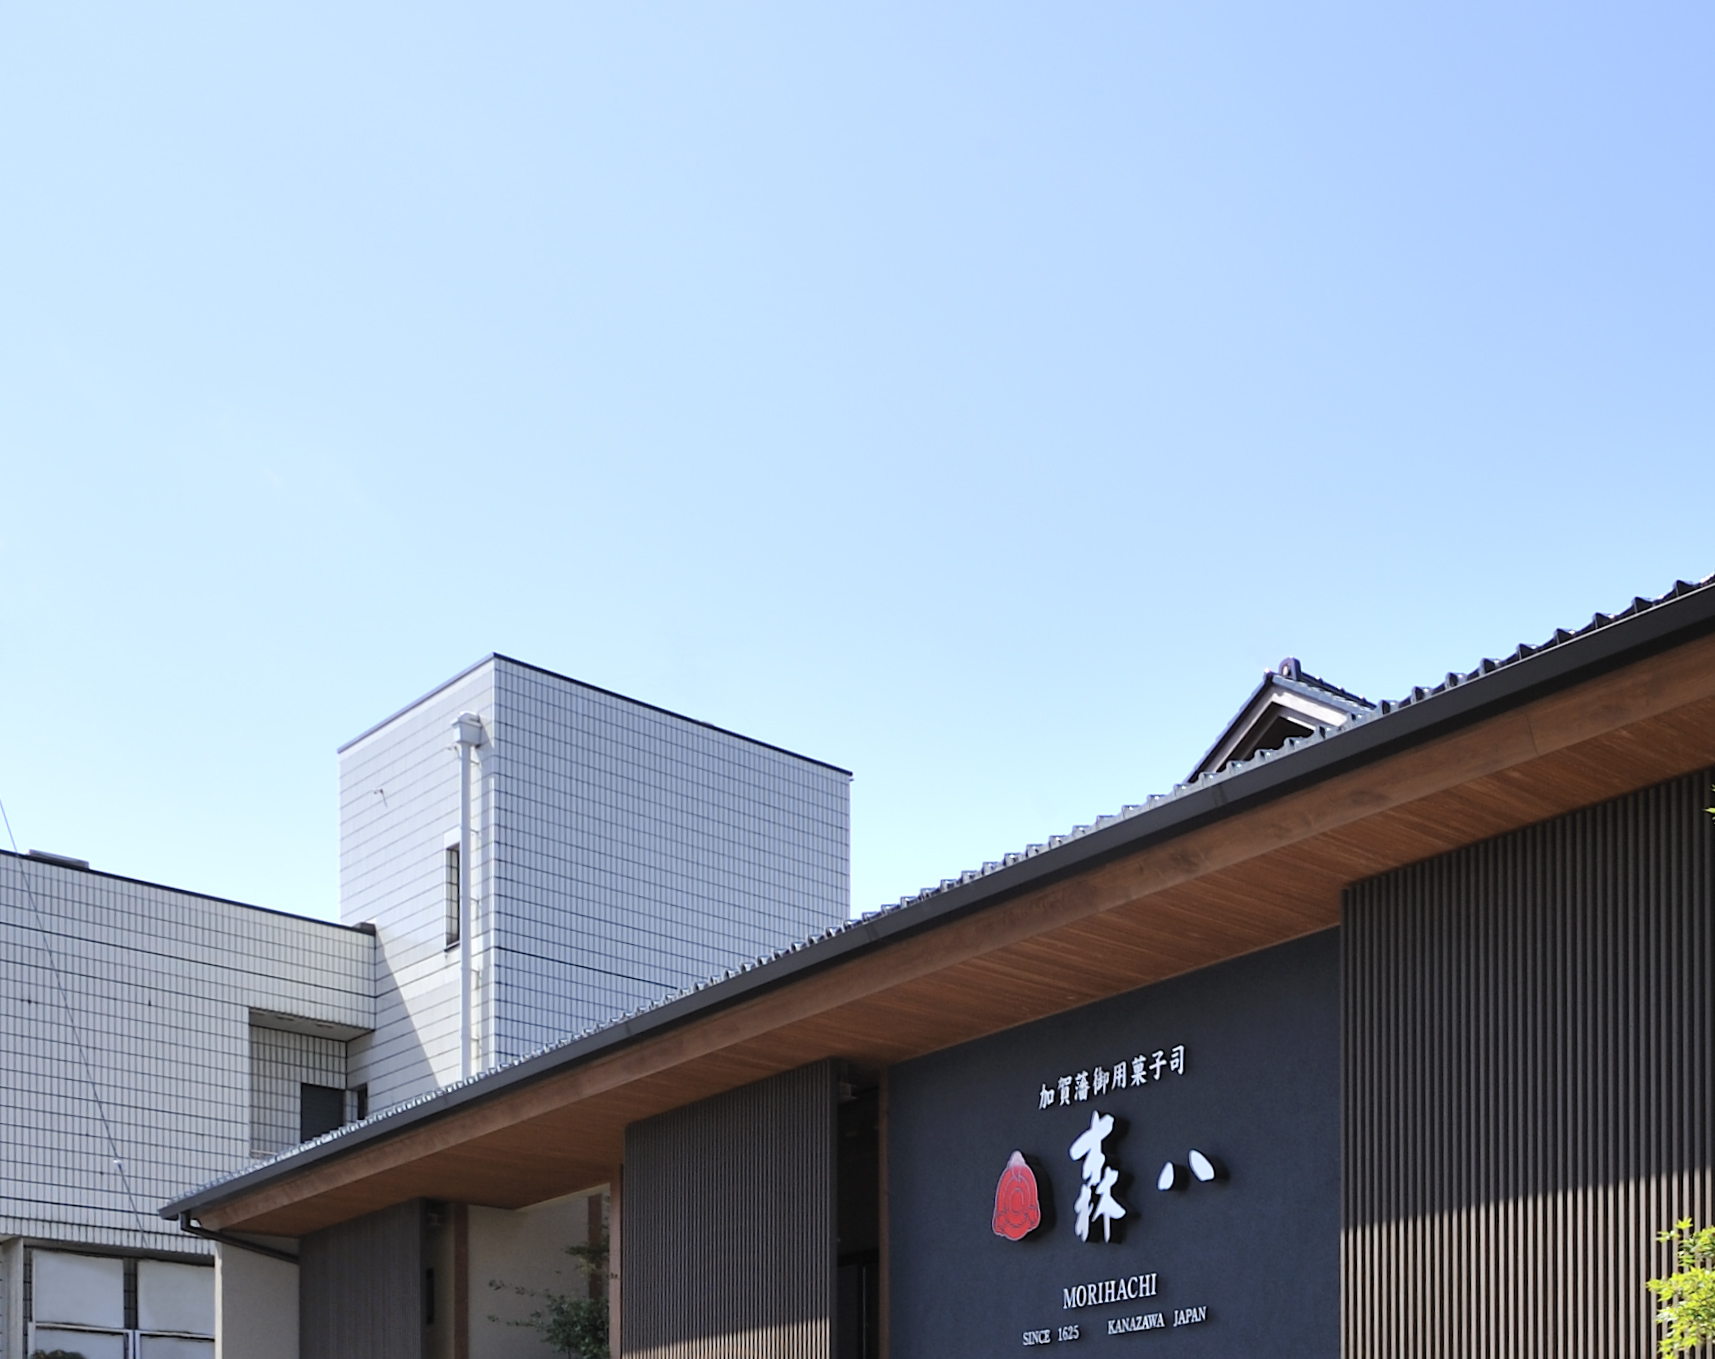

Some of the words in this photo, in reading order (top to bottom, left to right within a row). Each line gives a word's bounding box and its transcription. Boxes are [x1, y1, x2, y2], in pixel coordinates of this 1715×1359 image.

[1038, 1044, 1186, 1110] 加賀藩御用菓子司
[1069, 1109, 1216, 1243] 森八
[1062, 1272, 1158, 1310] MORIHACHI
[1022, 1328, 1052, 1346] SINCE
[1057, 1325, 1080, 1342] 1625
[1107, 1312, 1166, 1336] KANAZAWA
[1172, 1305, 1208, 1328] JAPAN
